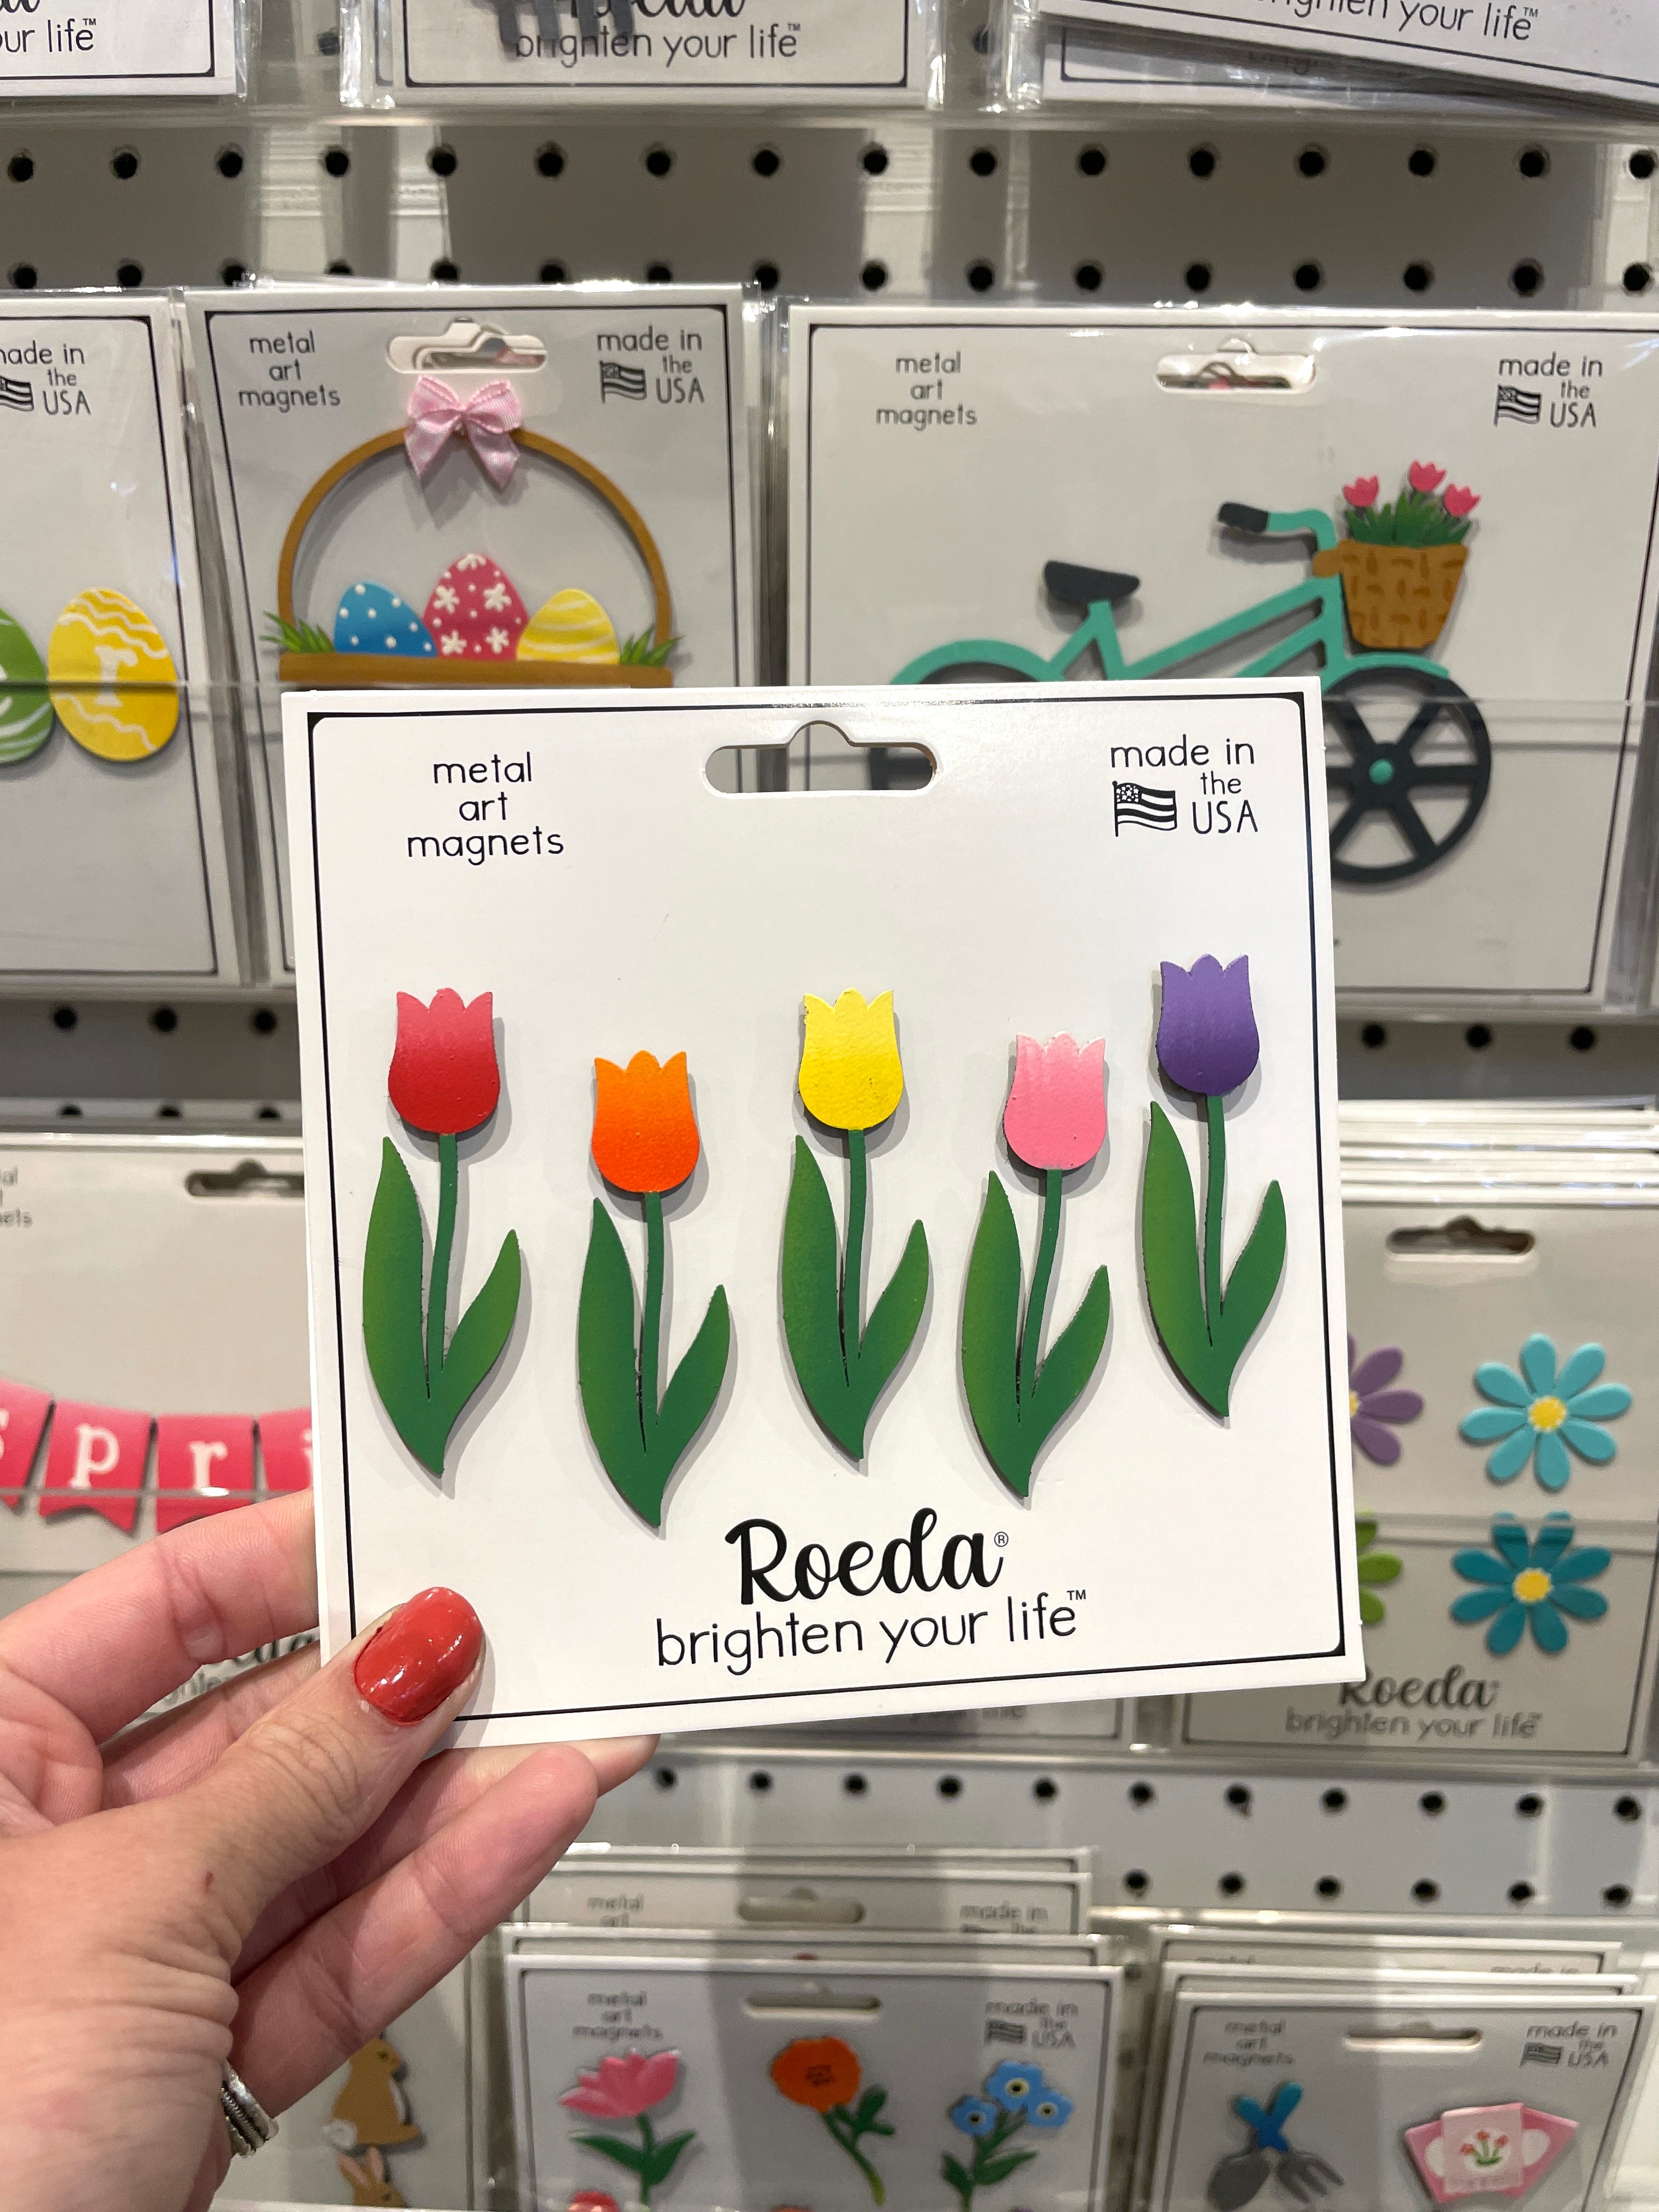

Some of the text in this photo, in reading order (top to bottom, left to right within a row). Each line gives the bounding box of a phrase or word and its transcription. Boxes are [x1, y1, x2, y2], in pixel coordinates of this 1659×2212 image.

[1399, 0, 1474, 31] your
[0, 30, 35, 53] ur
[663, 34, 737, 68] your
[249, 330, 315, 354] metal
[596, 325, 703, 352] made in
[63, 342, 84, 364] in
[662, 354, 693, 374] the
[895, 351, 962, 374] metal
[1498, 351, 1603, 377] made in
[46, 368, 77, 386] the
[268, 359, 301, 381] art
[238, 384, 341, 413] magnets
[655, 377, 705, 404] USA
[910, 379, 943, 400] art
[1560, 379, 1590, 399] the
[42, 390, 91, 415] USA
[1549, 402, 1596, 428] USA
[876, 404, 978, 431] magnets
[1110, 733, 1255, 768] made in
[433, 751, 532, 785] metal
[1200, 770, 1242, 795] the
[459, 791, 508, 821] art
[1192, 799, 1258, 834] USA
[407, 826, 565, 866] magnets
[656, 1611, 863, 1676] brighten
[879, 1611, 988, 1664] your
[1284, 1706, 1410, 1739] brighten
[1417, 1717, 1484, 1741] your
